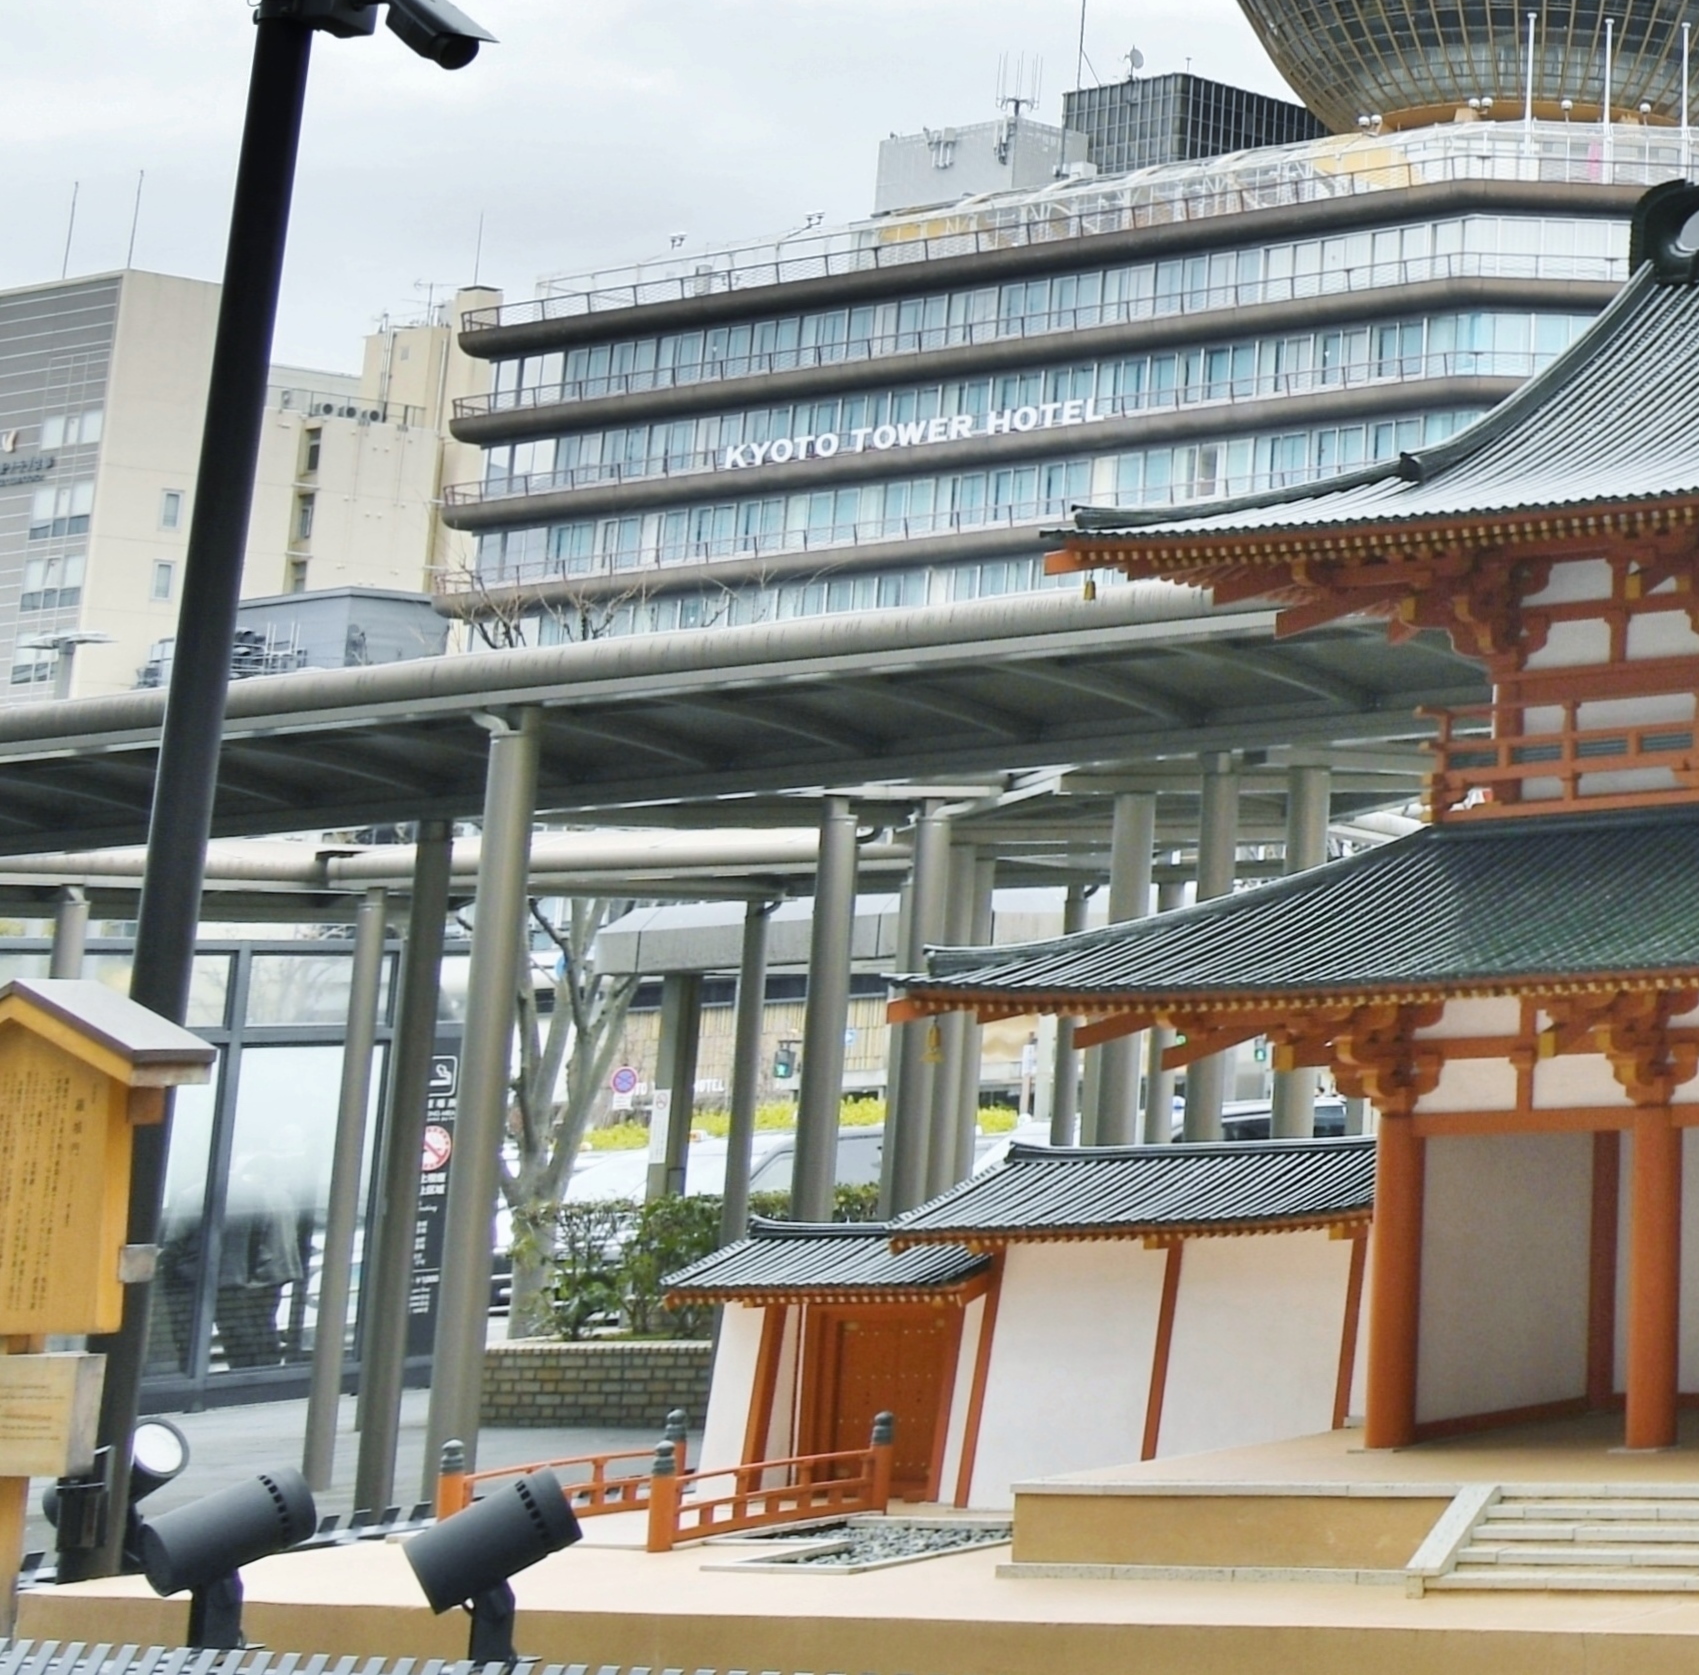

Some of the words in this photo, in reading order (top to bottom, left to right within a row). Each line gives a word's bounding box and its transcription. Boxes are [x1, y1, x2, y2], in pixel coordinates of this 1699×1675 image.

[725, 434, 839, 470] KYOTO
[850, 415, 973, 453] TOWER
[986, 398, 1105, 435] HOTEL
